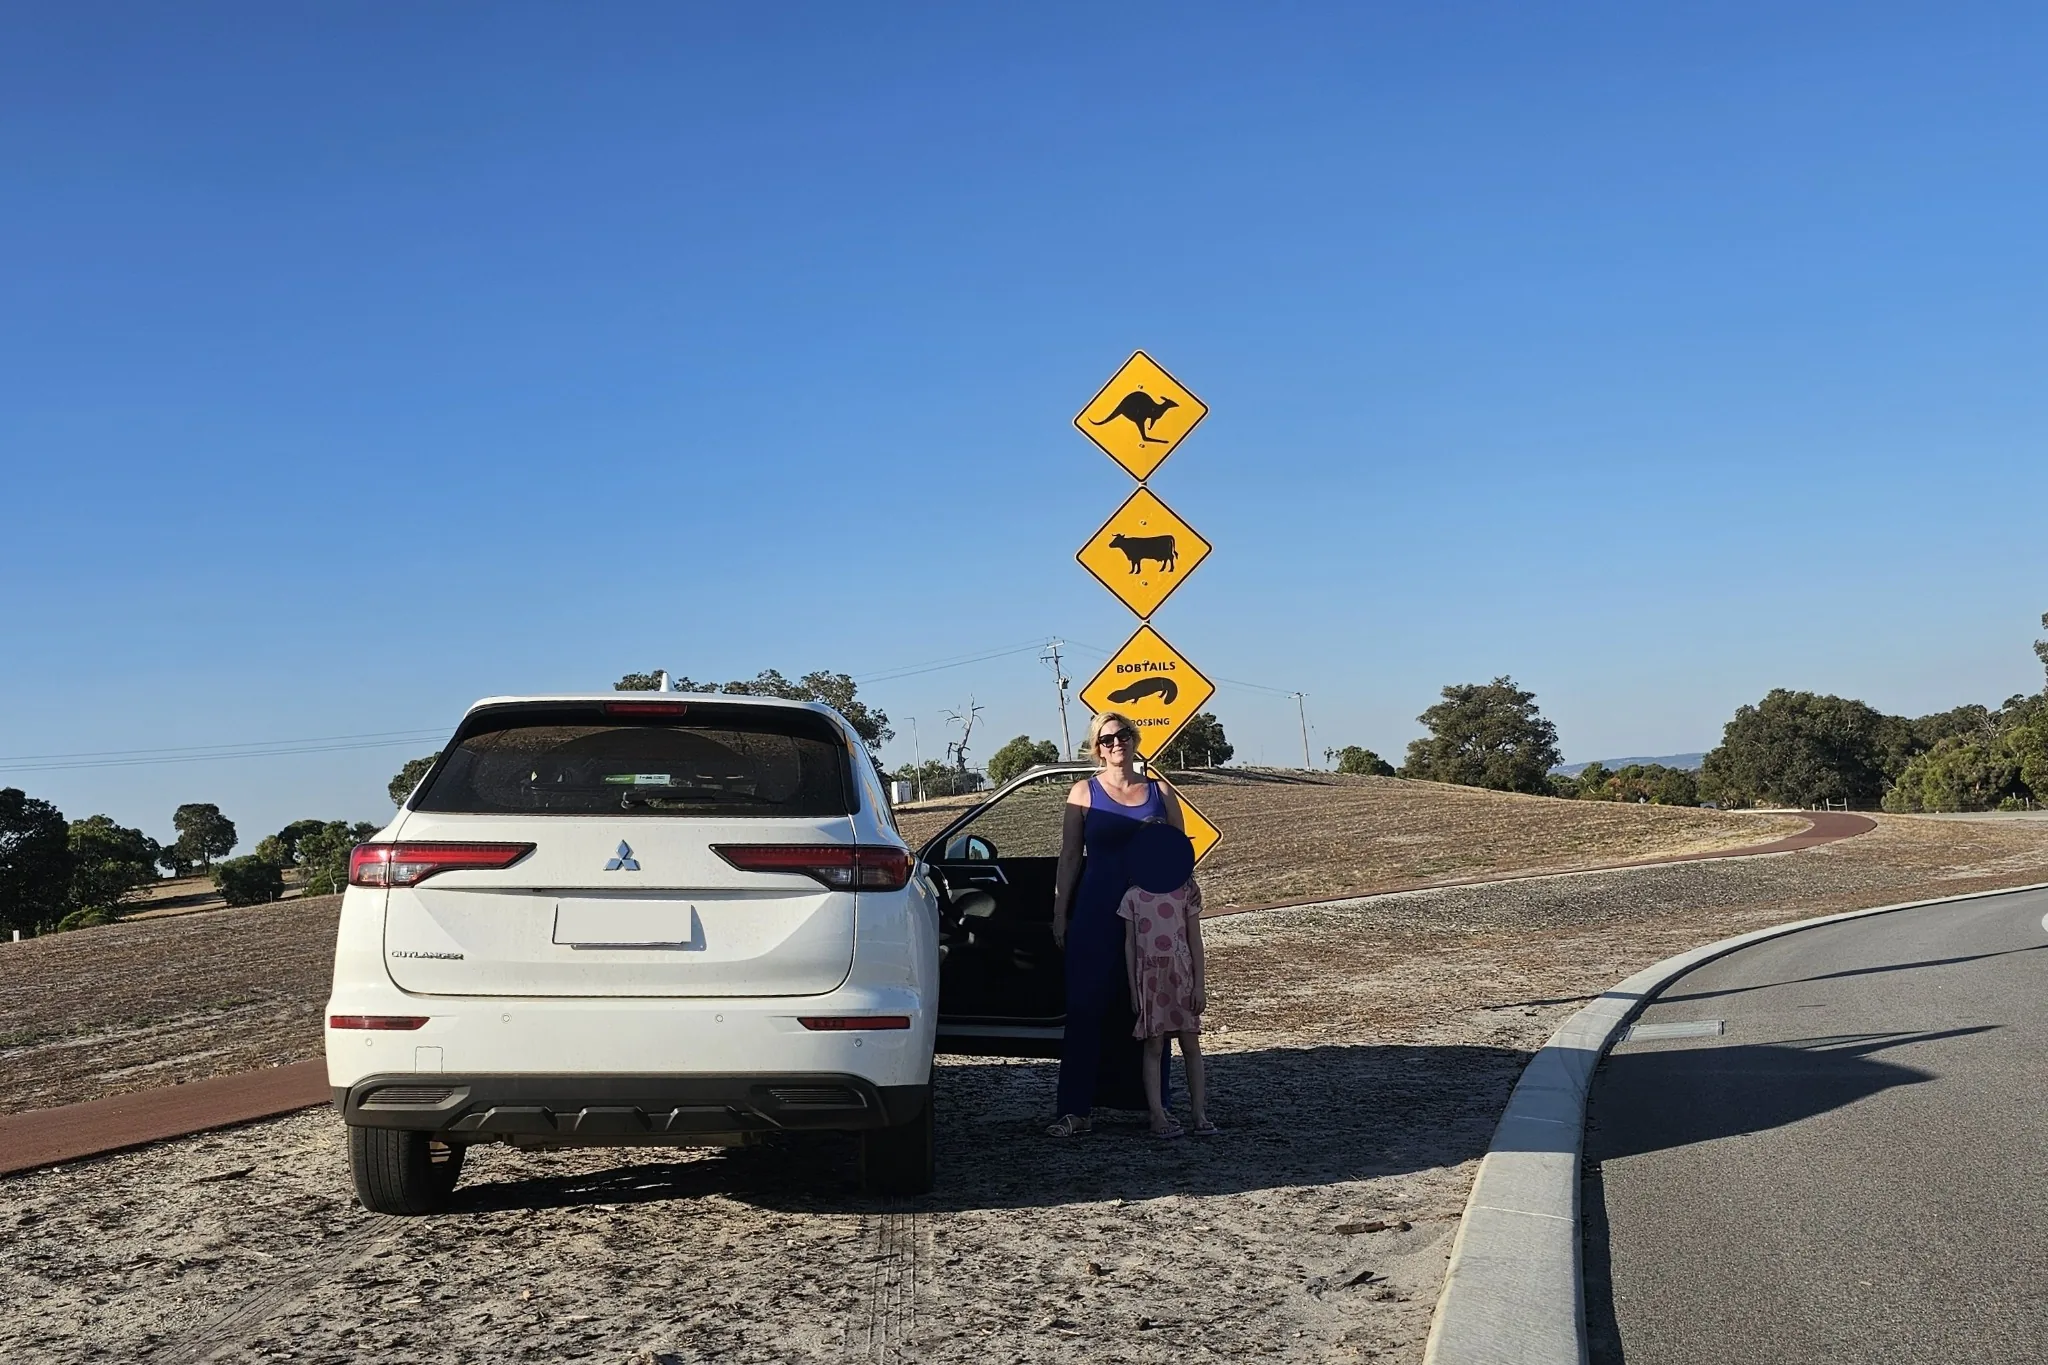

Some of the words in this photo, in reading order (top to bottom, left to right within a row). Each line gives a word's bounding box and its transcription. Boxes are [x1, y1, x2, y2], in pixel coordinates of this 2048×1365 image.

[1116, 662, 1176, 673] BOBTAILS
[1131, 717, 1170, 727] ROSSING
[391, 951, 465, 961] OUTLANDER
